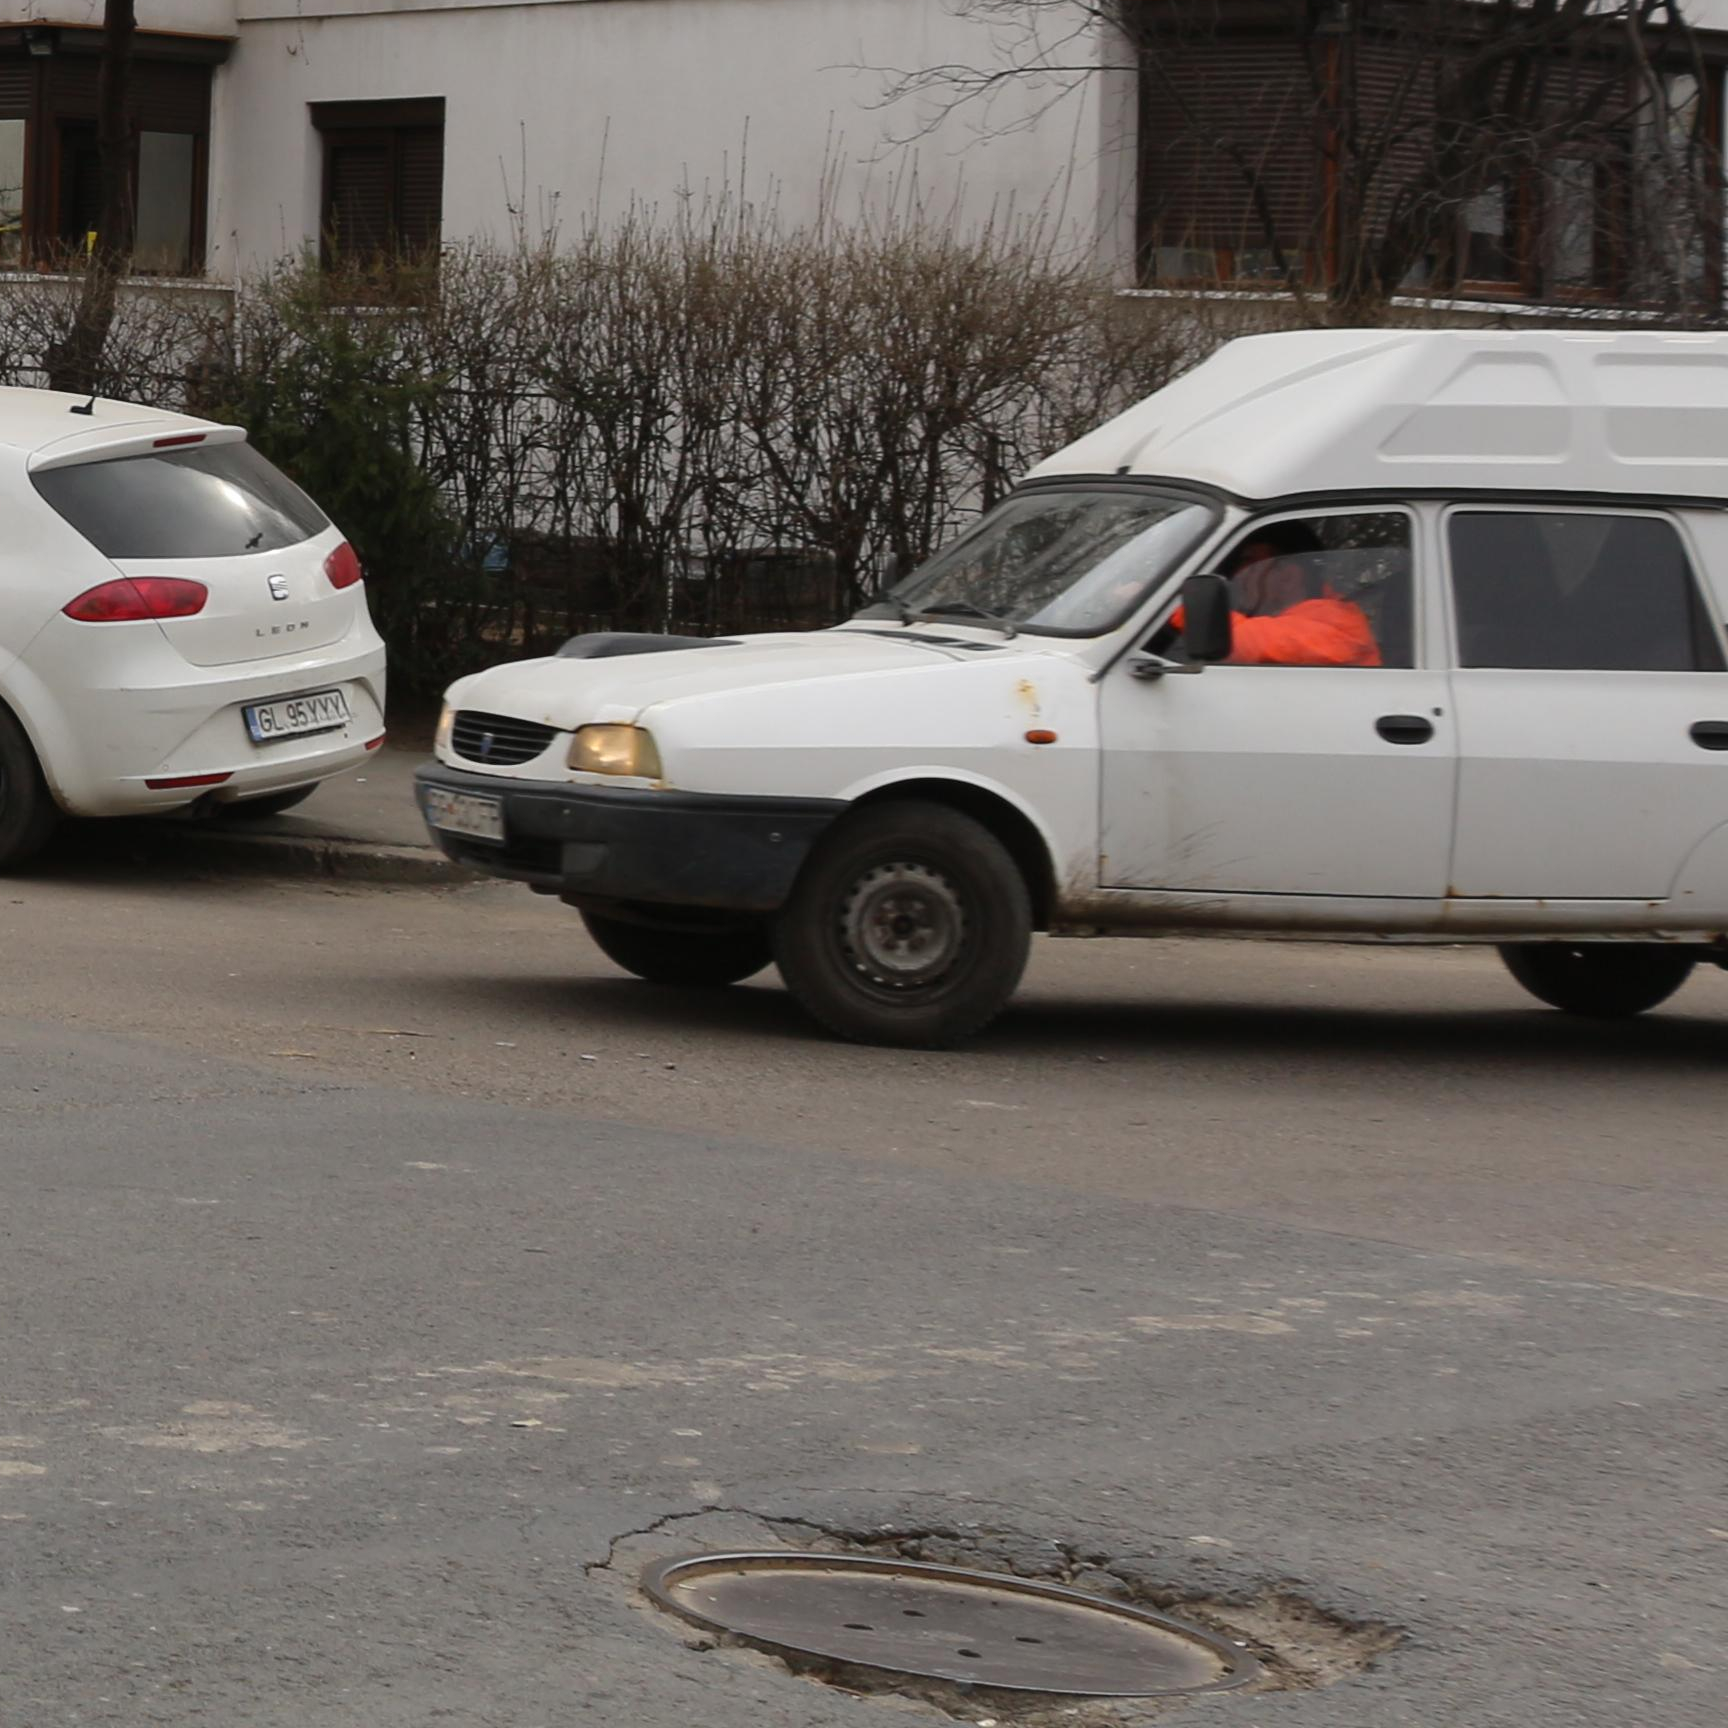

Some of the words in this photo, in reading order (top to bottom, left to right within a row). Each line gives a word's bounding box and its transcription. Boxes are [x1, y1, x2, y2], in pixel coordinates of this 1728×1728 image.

[255, 621, 310, 638] LEON
[258, 706, 285, 733] GL
[286, 701, 309, 728] 95
[306, 694, 344, 724] YYY
